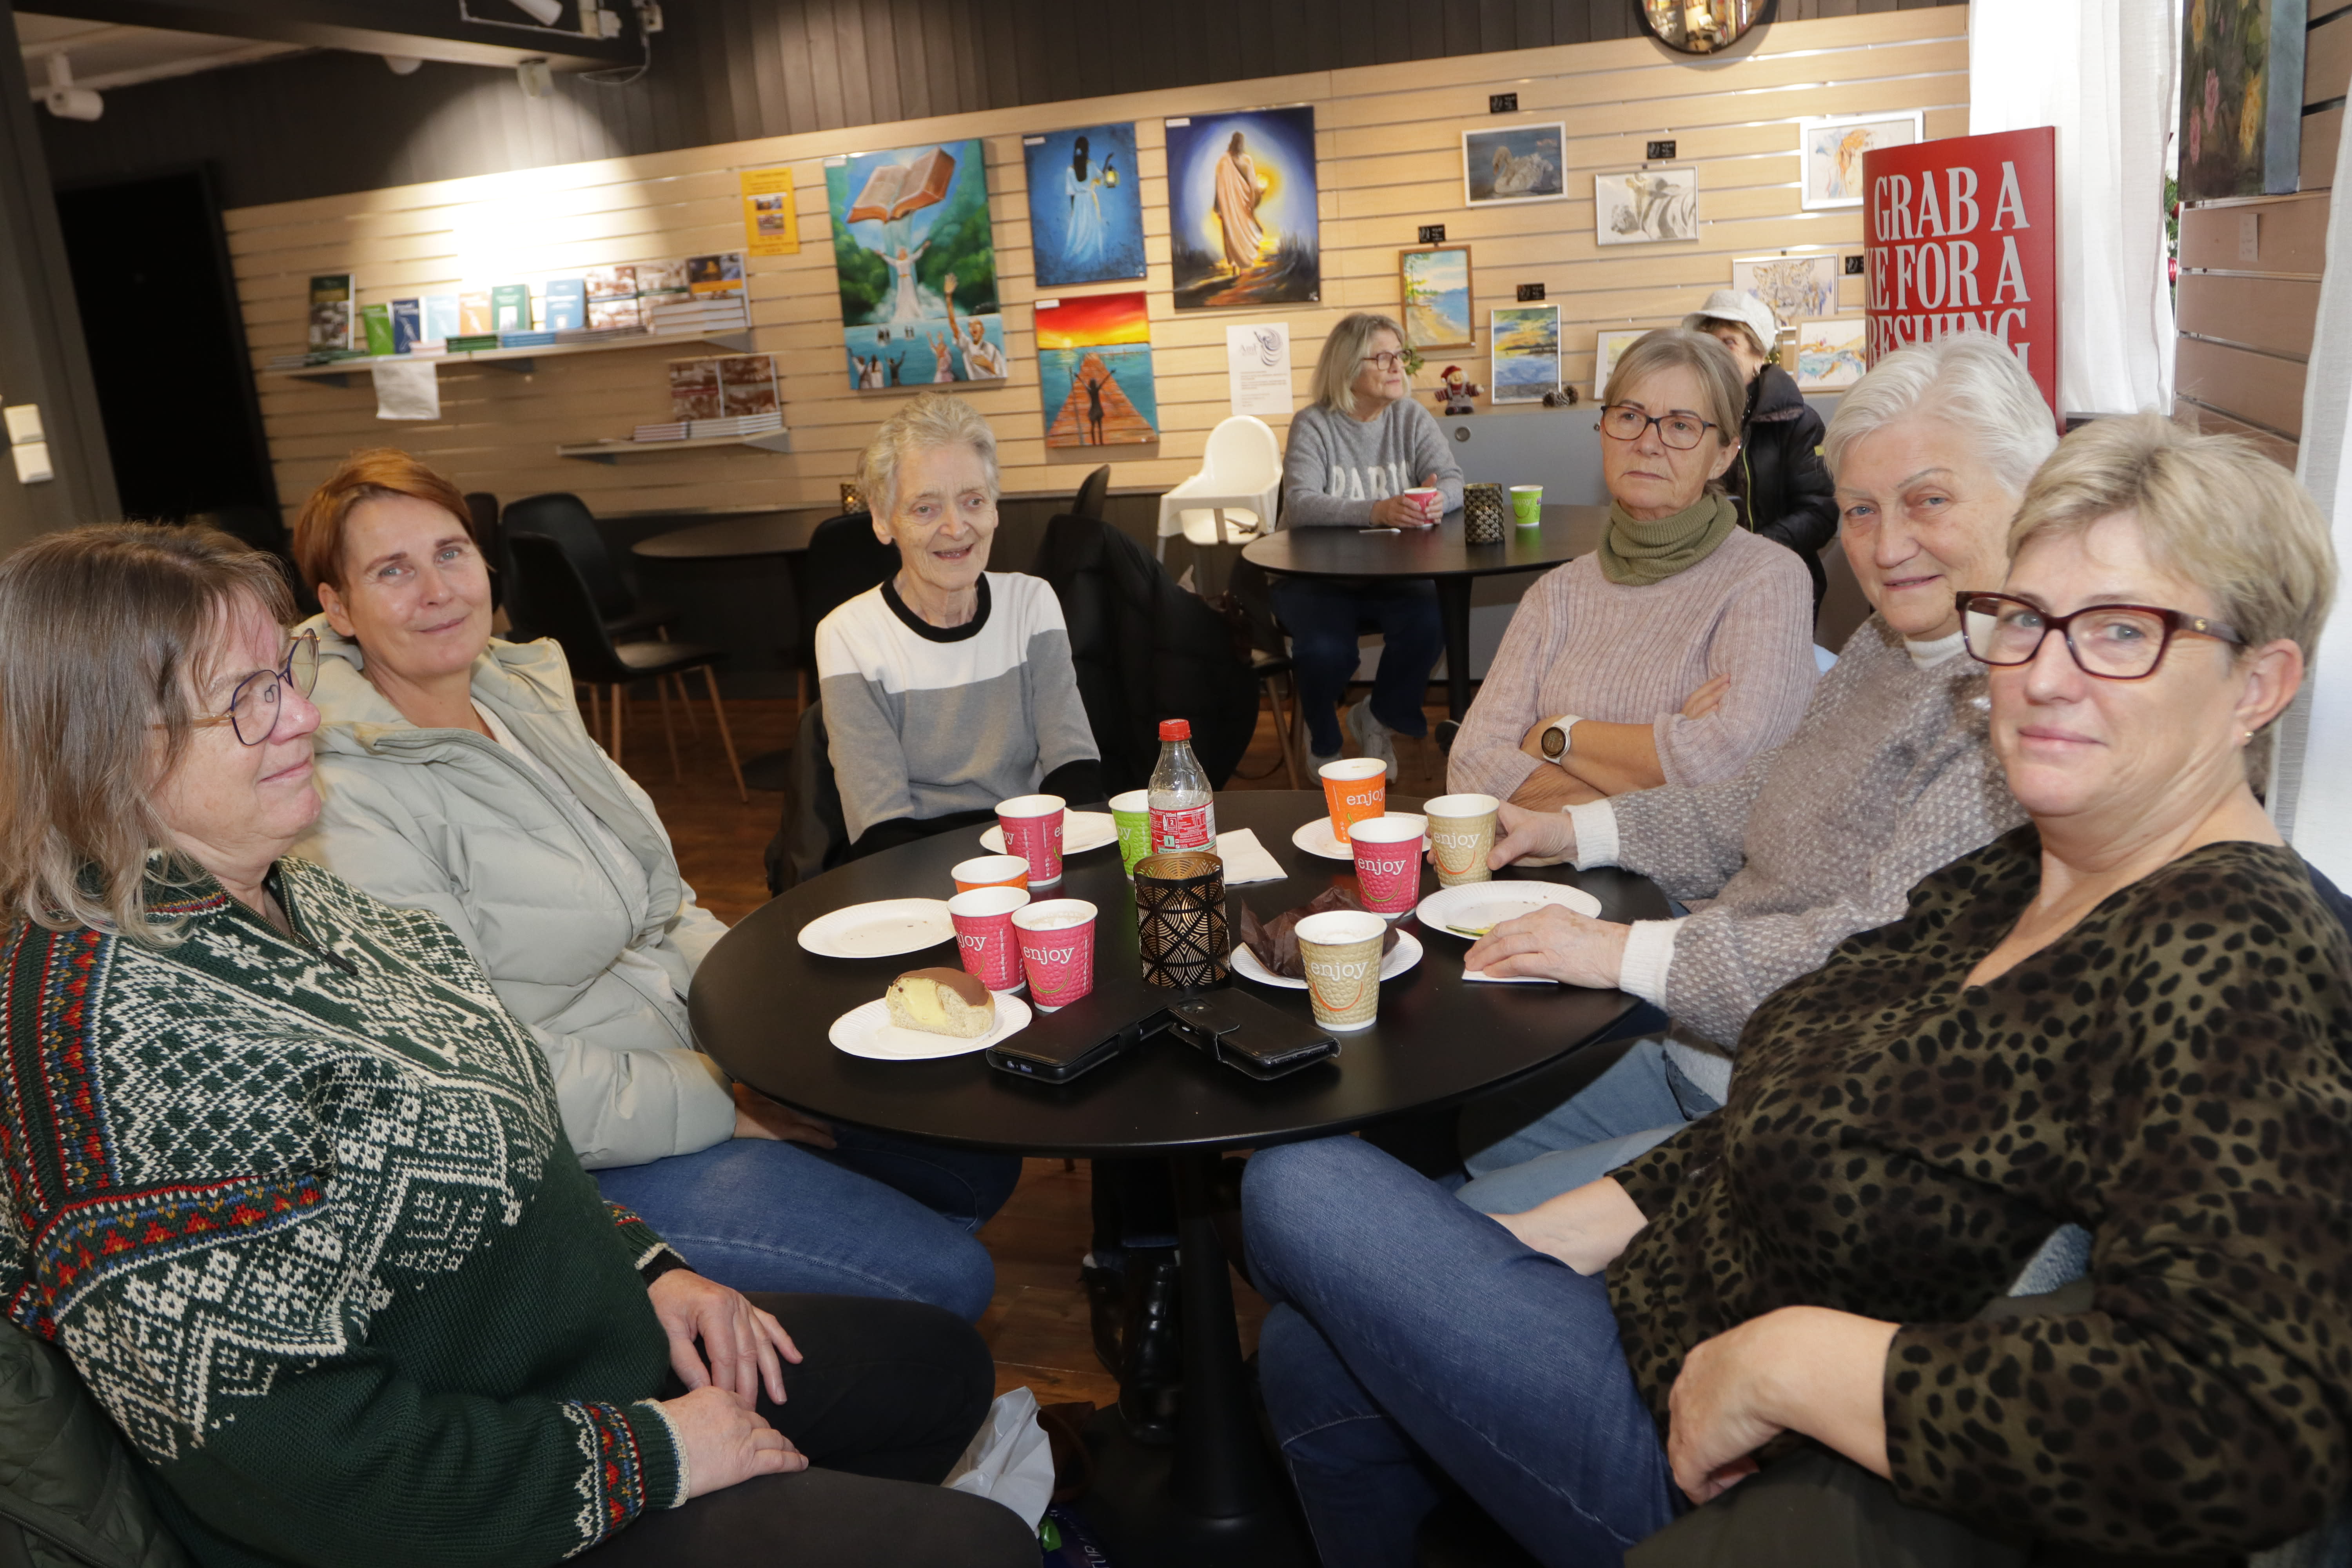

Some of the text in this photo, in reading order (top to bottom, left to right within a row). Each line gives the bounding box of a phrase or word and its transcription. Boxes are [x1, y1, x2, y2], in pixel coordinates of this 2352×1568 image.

[1874, 161, 2030, 242] GRAB A
[1865, 236, 2031, 310] KE FOR A
[1346, 787, 1385, 806] enjoy
[1434, 832, 1481, 849] enjoy
[1358, 858, 1406, 875] enjoy
[1023, 946, 1075, 965] enjoy
[1311, 961, 1369, 982] enjoy
